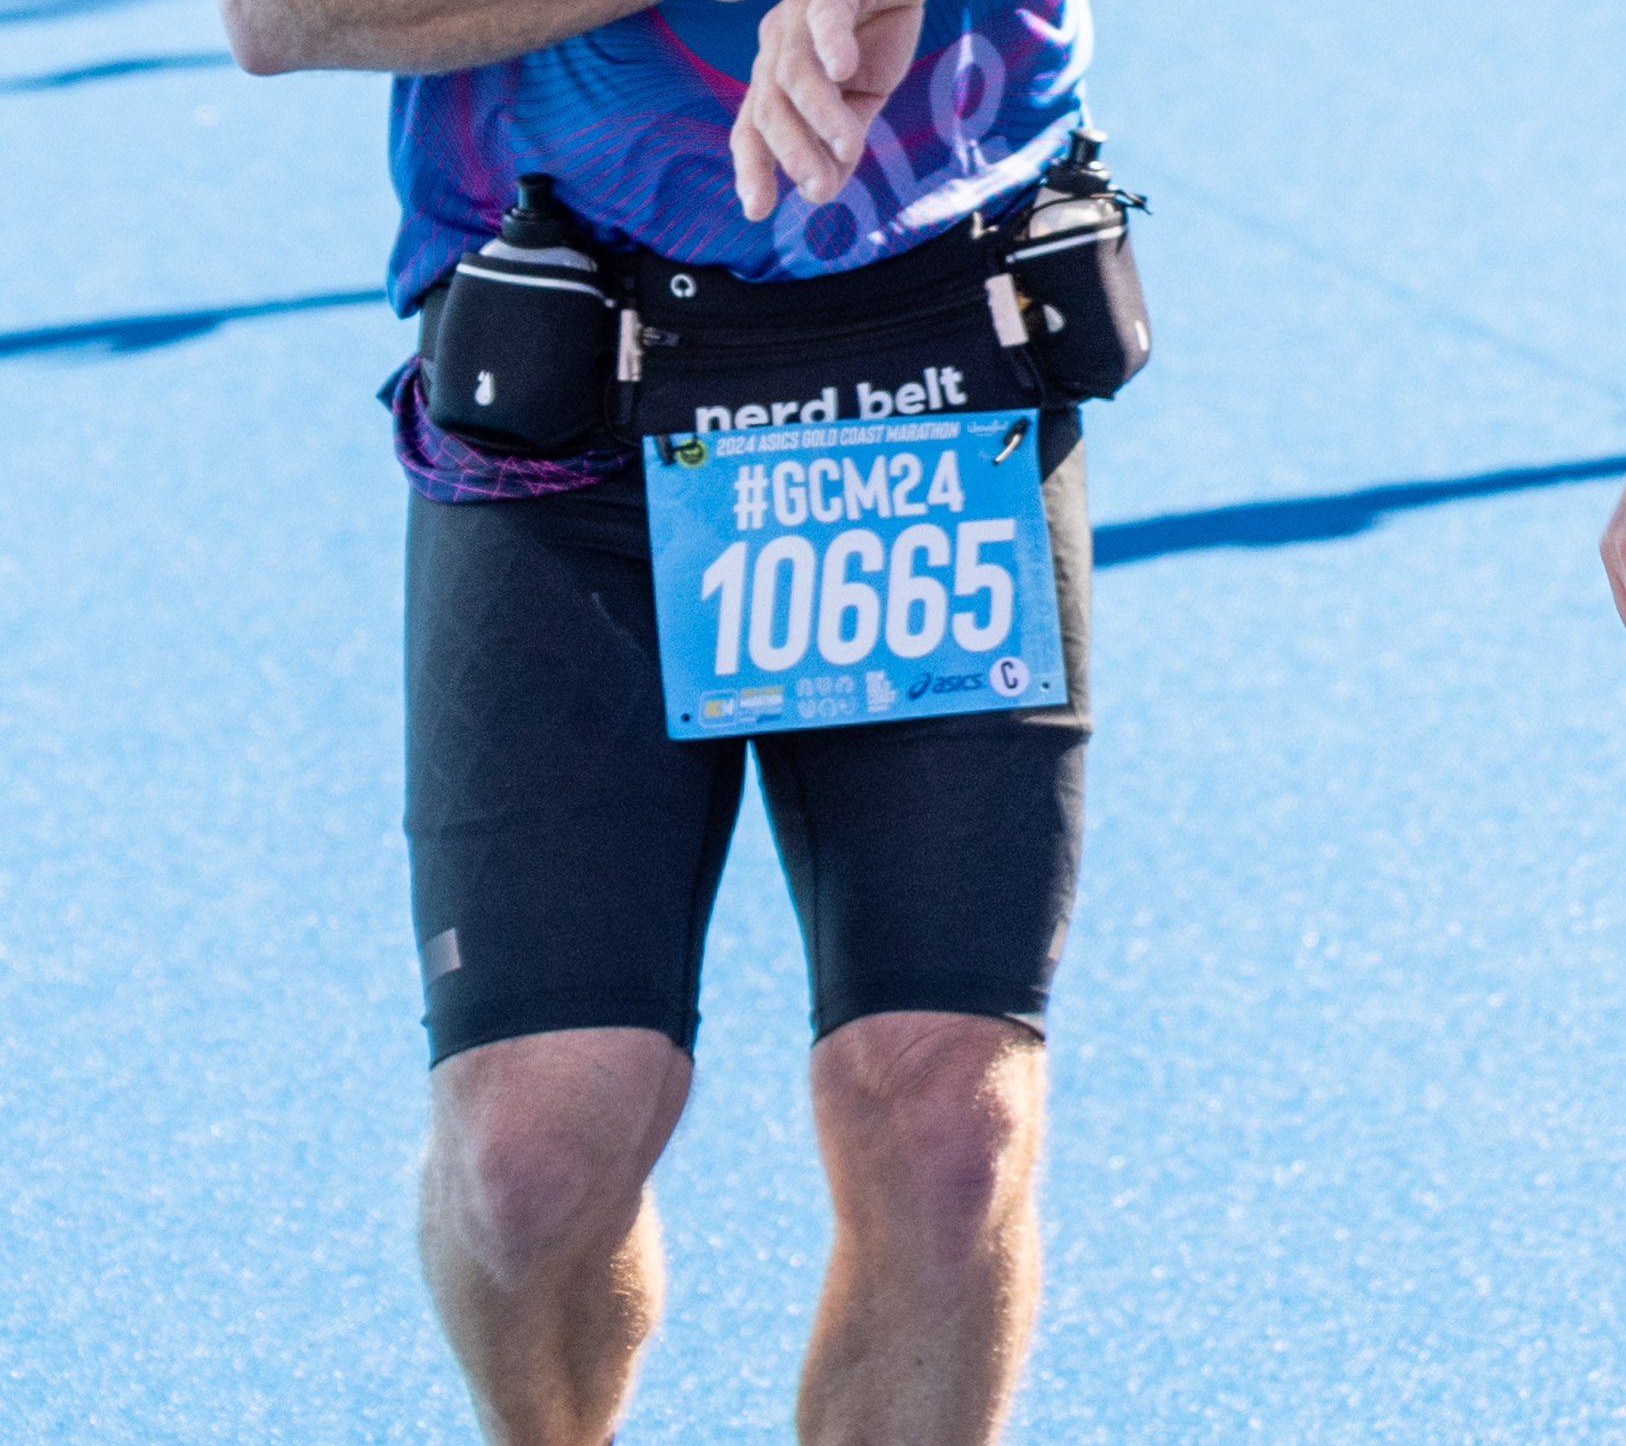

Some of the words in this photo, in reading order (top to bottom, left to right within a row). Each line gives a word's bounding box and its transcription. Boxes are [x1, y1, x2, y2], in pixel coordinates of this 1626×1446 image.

[696, 387, 837, 433] nerd
[857, 366, 967, 420] belt
[716, 436, 756, 458] 2024
[758, 432, 799, 452] ASICS
[802, 429, 838, 449] GOLD
[839, 425, 885, 446] COAST
[886, 421, 959, 443] MARATHON
[734, 450, 965, 531] #GCM24
[700, 518, 1016, 676] 10665
[1000, 661, 1019, 690] C
